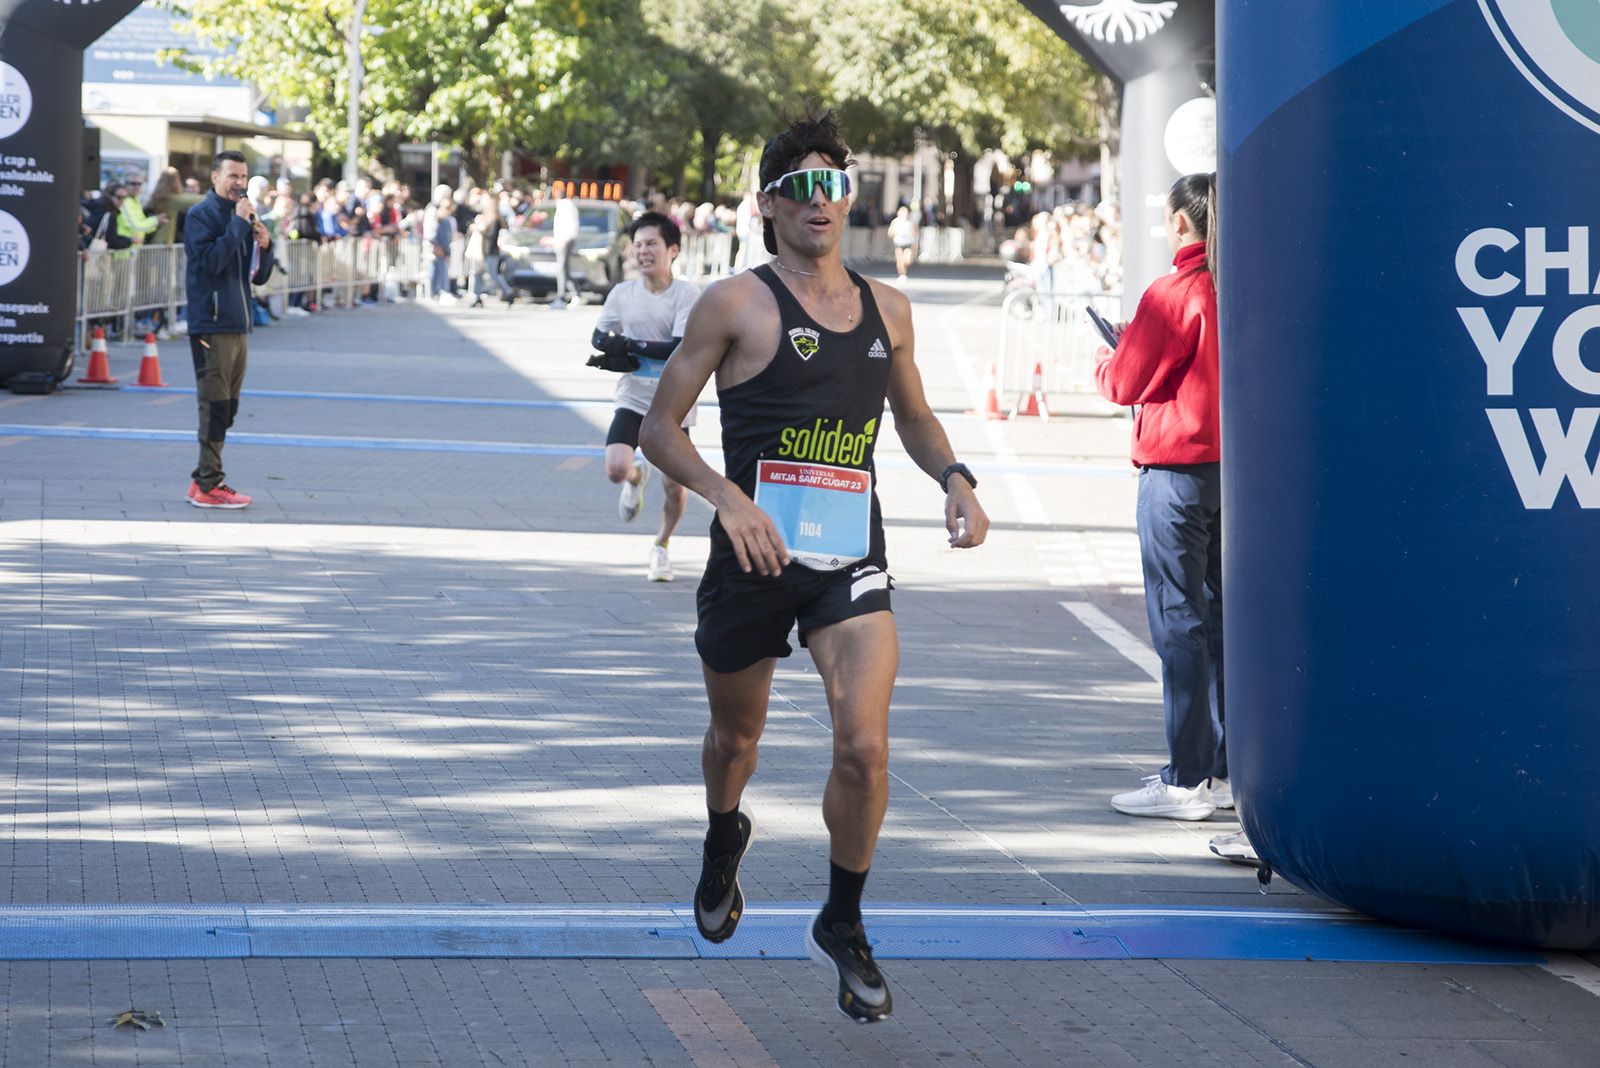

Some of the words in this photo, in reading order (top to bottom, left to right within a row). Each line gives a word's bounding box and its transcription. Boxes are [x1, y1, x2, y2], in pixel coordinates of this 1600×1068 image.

[1455, 226, 1600, 297] CH
[868, 350, 888, 359] adidas
[778, 418, 870, 466] solideo
[770, 472, 796, 482] MITJA
[799, 474, 822, 485] SANT
[822, 477, 851, 488] CUGAT
[850, 481, 862, 490] 23
[800, 521, 822, 538] 1104
